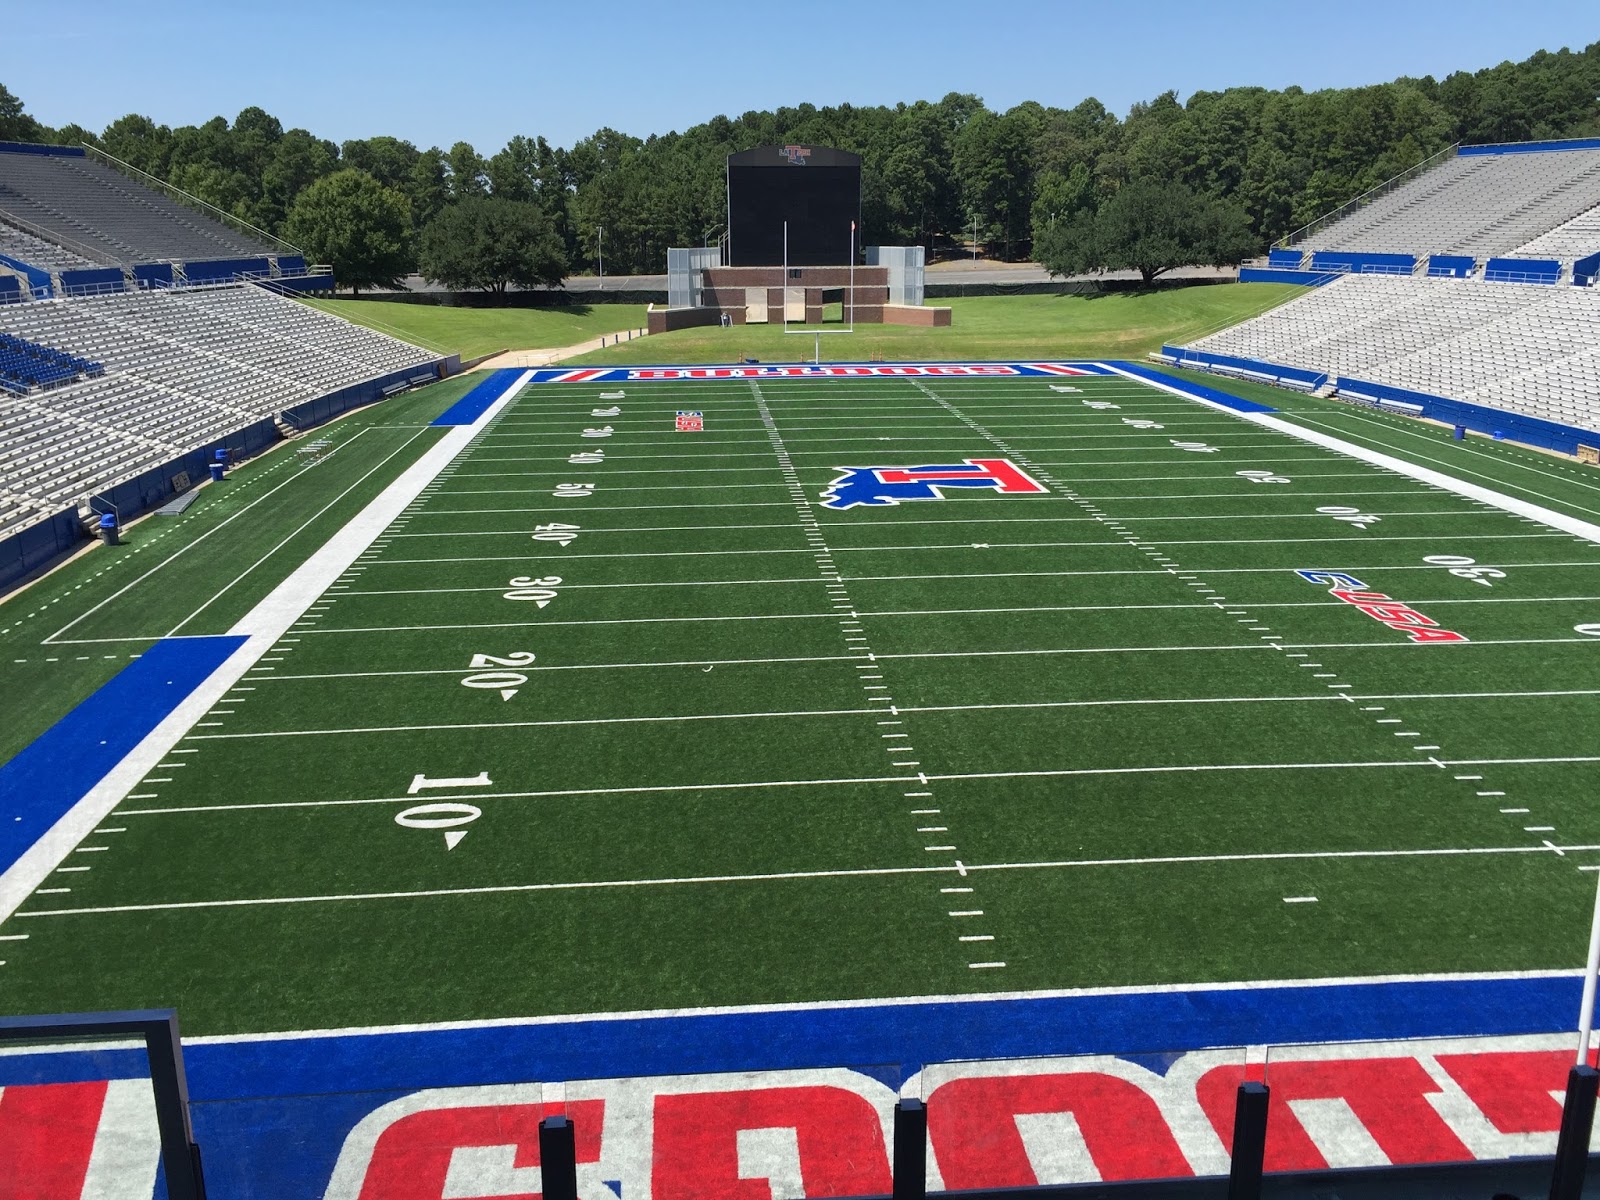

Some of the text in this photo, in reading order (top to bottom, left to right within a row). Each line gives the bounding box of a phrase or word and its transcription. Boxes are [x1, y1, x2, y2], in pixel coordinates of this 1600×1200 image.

[627, 366, 1021, 379] BULLDOGS
[552, 483, 595, 497] 50
[532, 523, 580, 540] 40
[1423, 555, 1506, 578] 30
[503, 576, 563, 600] 30
[461, 652, 536, 688] 20
[394, 771, 493, 828] 10
